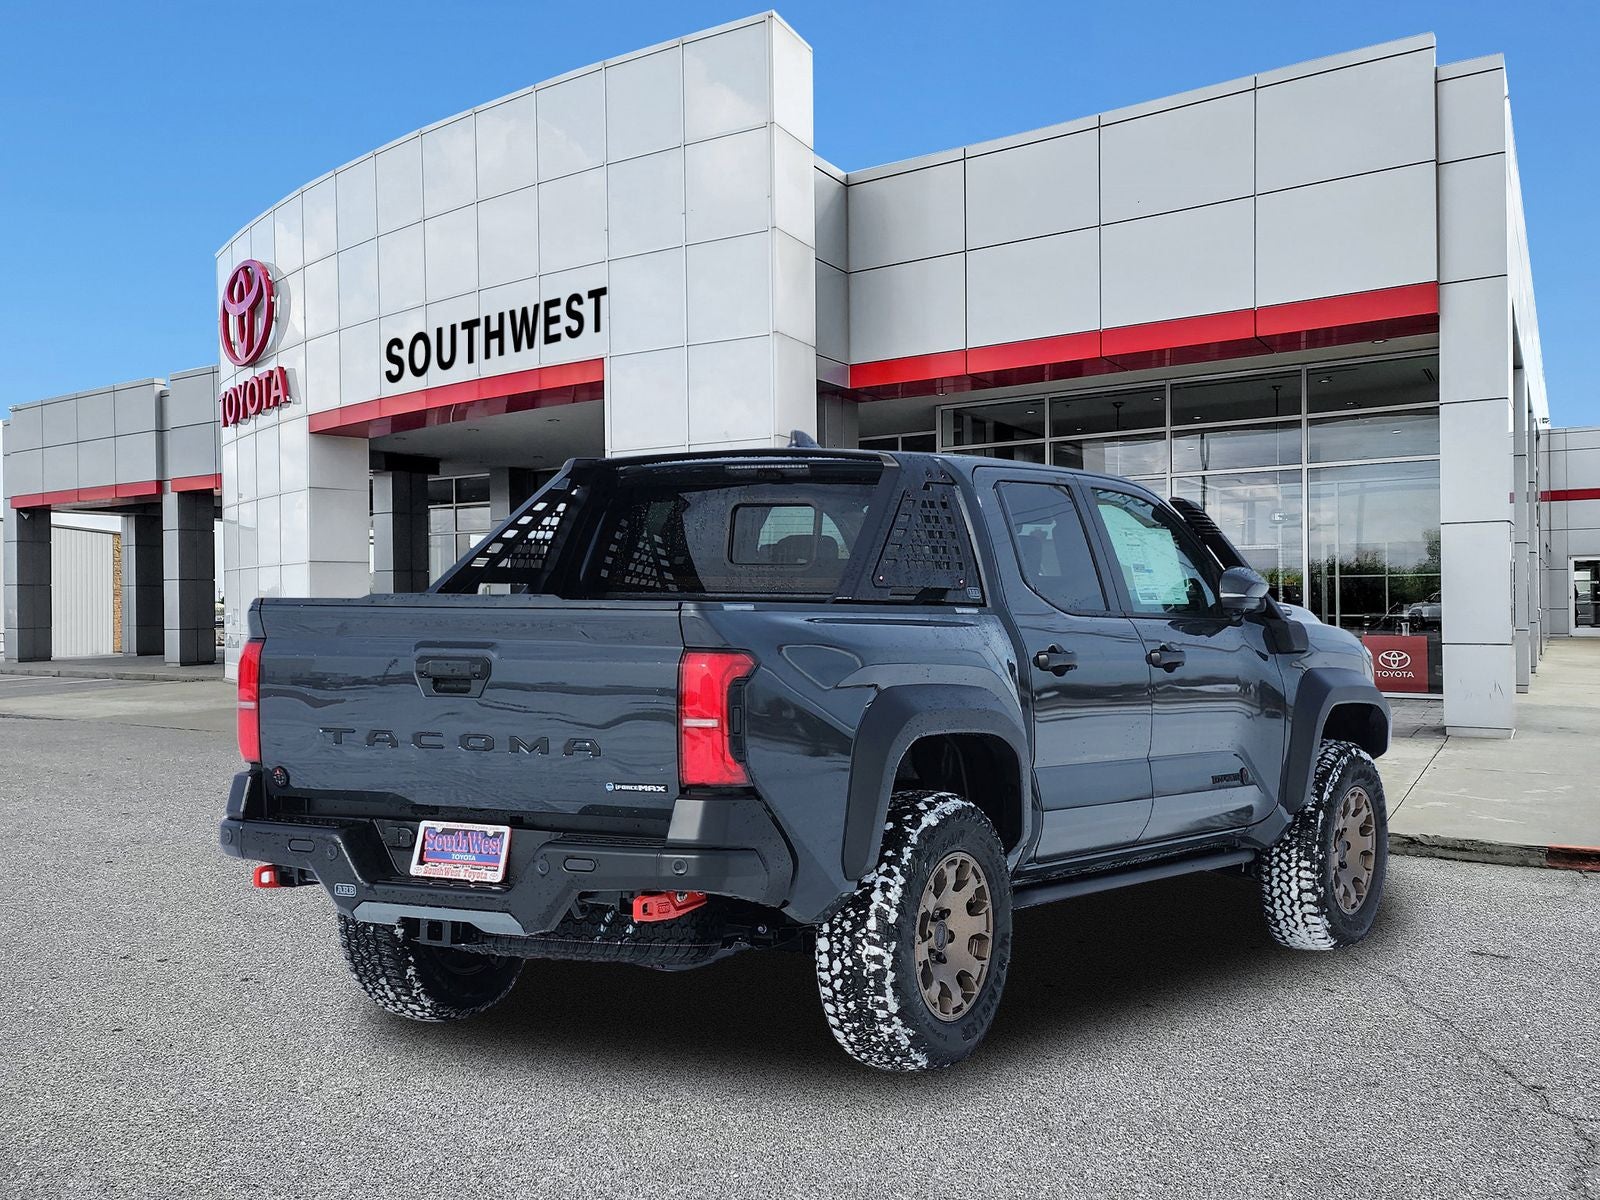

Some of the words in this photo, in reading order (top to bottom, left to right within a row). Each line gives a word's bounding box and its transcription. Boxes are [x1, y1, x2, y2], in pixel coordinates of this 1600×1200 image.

[385, 286, 607, 384] SOUTHWEST
[219, 366, 290, 427] TOYOTA
[1375, 670, 1415, 678] TOYOTA
[319, 727, 601, 757] TACOMA
[424, 827, 504, 855] SouthWest
[451, 853, 476, 861] TOYOTA
[463, 869, 488, 879] Toyota
[337, 885, 355, 895] ARB
